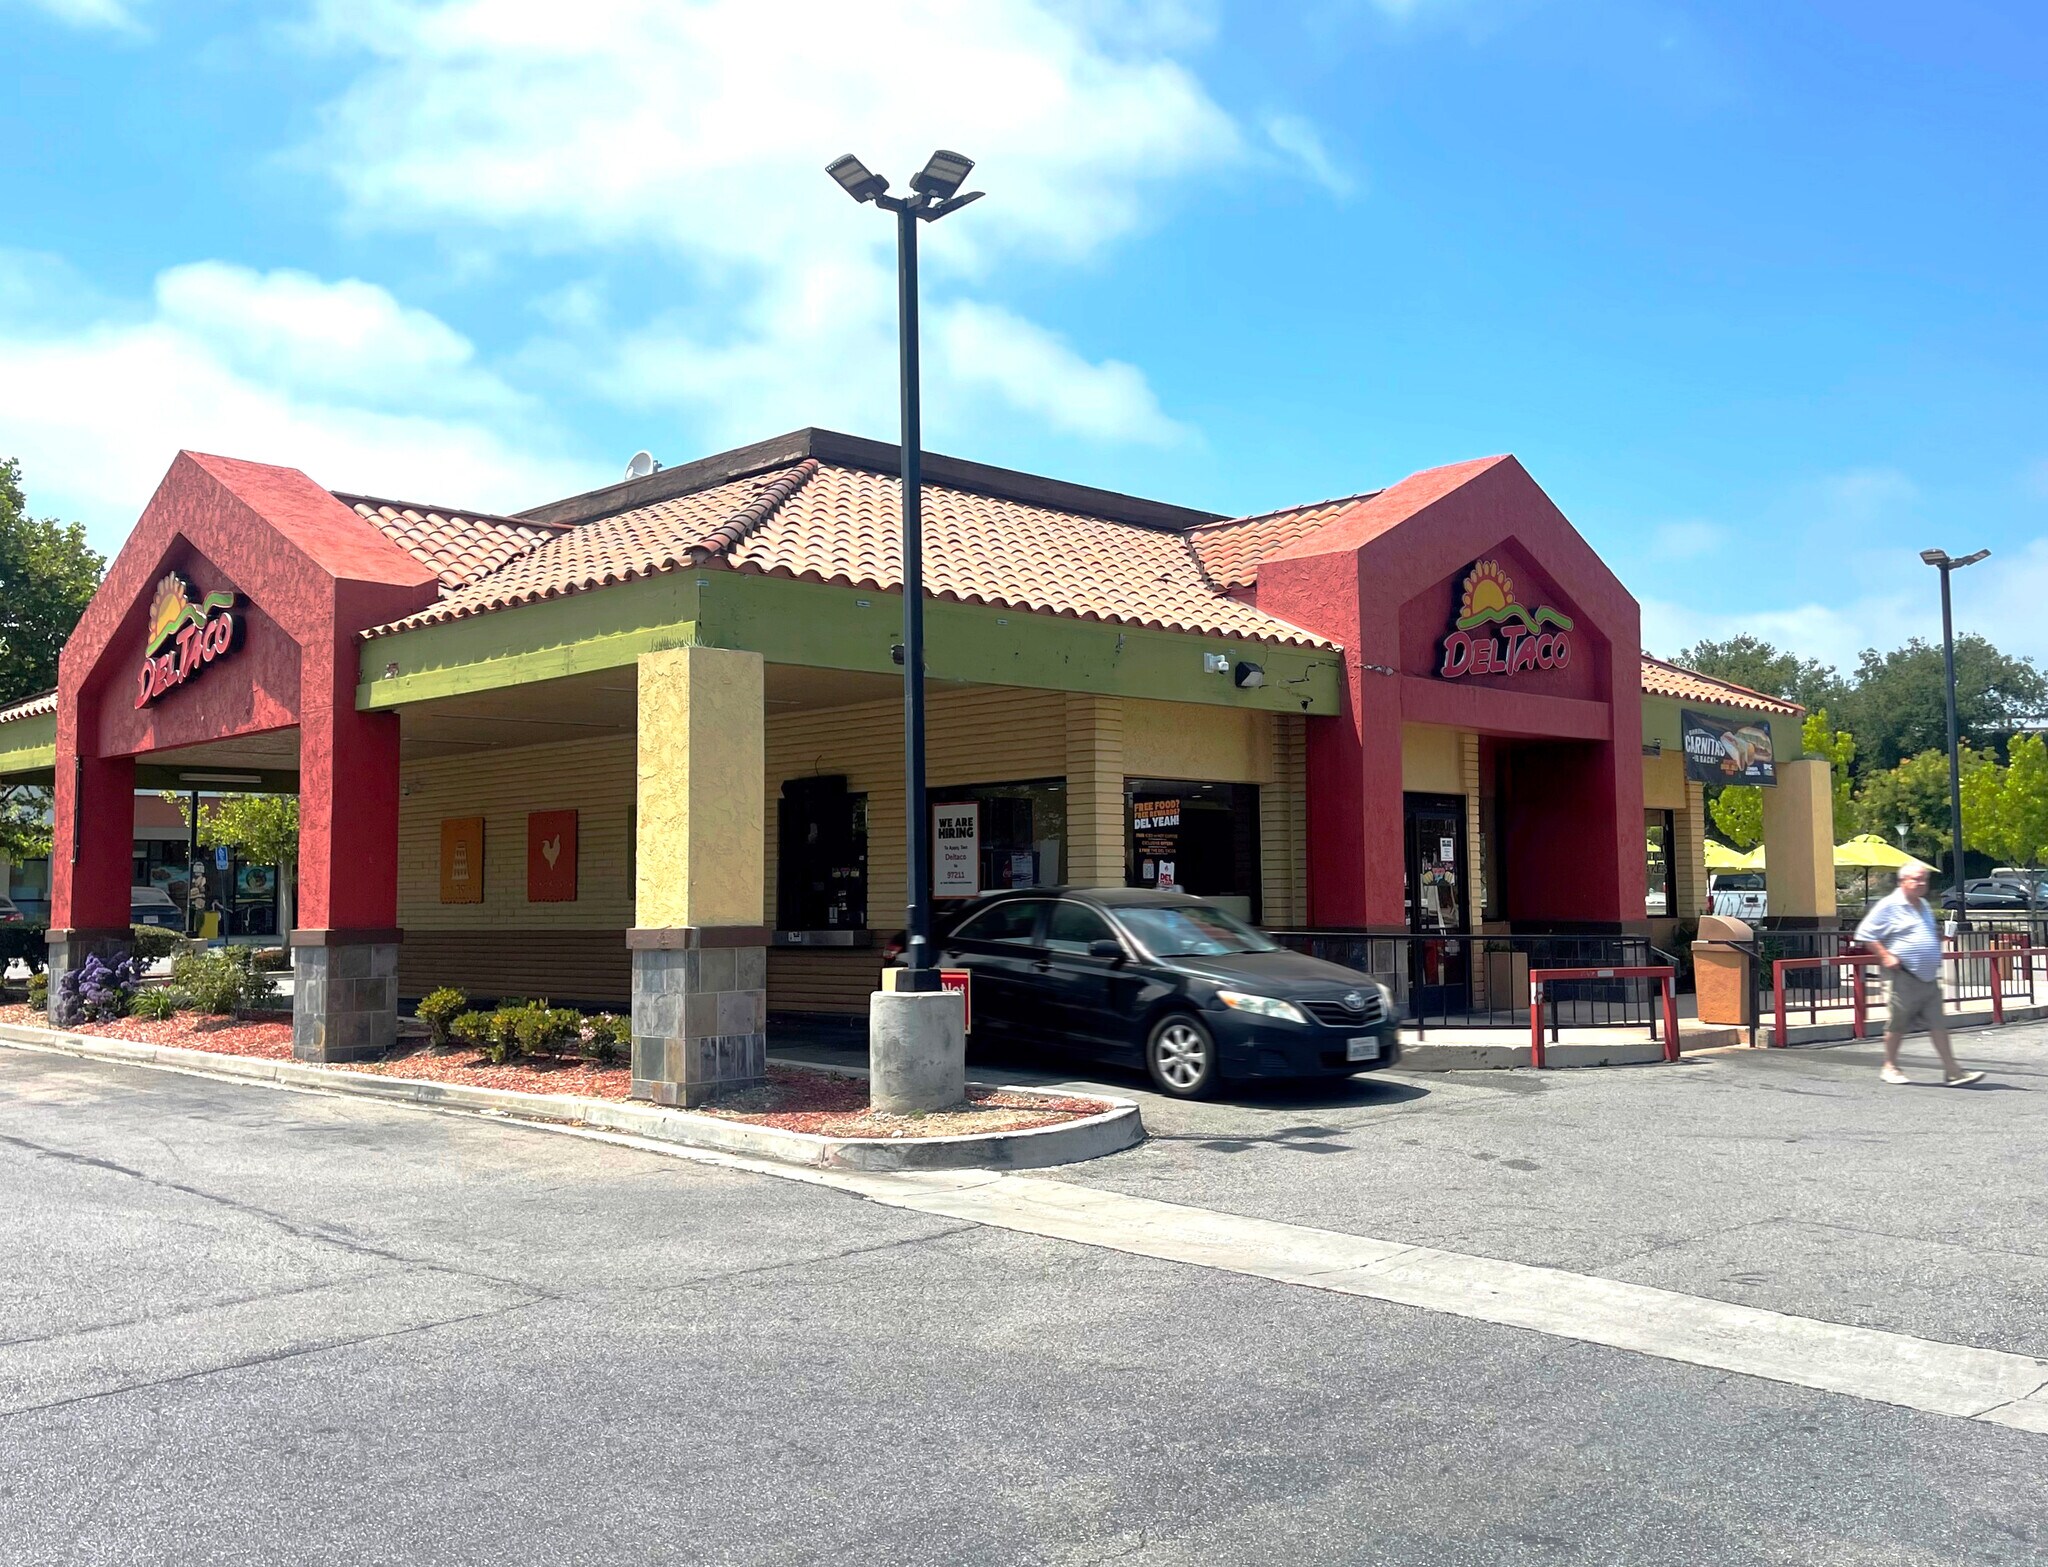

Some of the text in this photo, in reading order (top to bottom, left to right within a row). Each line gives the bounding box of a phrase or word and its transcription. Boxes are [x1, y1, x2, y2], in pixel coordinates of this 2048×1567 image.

[1441, 625, 1571, 678] DEL TACO
[135, 612, 234, 709] DEL TACO
[1685, 735, 1726, 757] CARNITAS
[1134, 799, 1180, 812] FREE FOOD?
[939, 817, 974, 827] WE ARE
[1134, 815, 1180, 830] DEL YEAH!
[938, 827, 974, 839] HIRING
[945, 853, 967, 861] Deltaco
